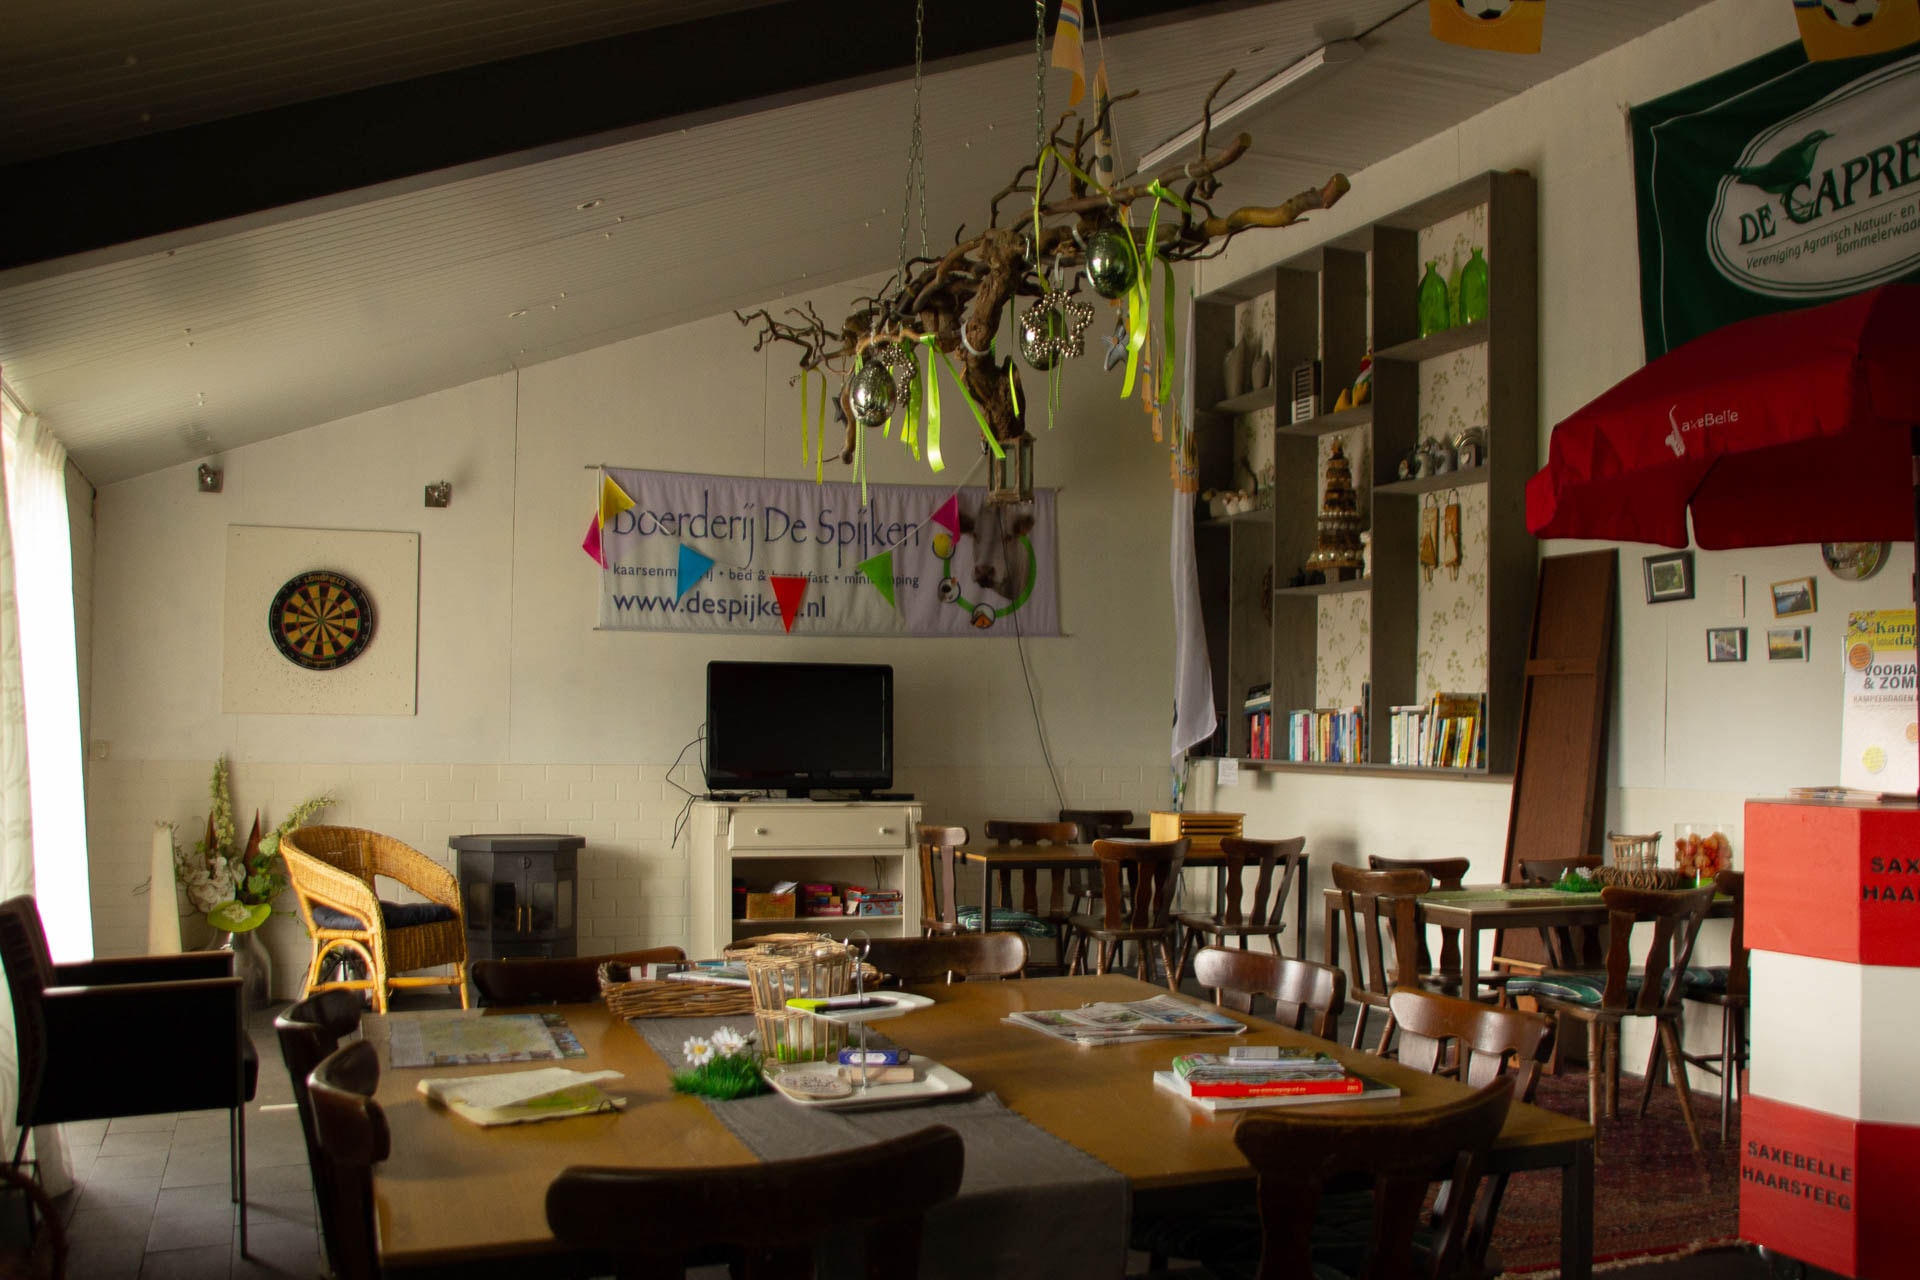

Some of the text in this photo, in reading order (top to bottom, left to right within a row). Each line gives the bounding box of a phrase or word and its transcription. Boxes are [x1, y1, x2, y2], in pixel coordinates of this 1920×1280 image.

[1739, 203, 1776, 246] DE
[1746, 204, 1915, 270] Vereniging Agrarisch Natuur- en
[764, 507, 807, 545] De
[816, 498, 919, 568] Spijken
[613, 563, 713, 581] kaarsenmij
[728, 568, 752, 580] bed
[757, 570, 767, 581] &
[844, 571, 919, 588] miniping
[613, 591, 826, 622] www.despijke.nl
[1864, 677, 1874, 689] &
[1871, 856, 1920, 873] SAX
[1863, 885, 1920, 902] HAA
[1748, 1141, 1852, 1184] SAXEBELLE
[1742, 1165, 1851, 1211] HAARSTEEG
